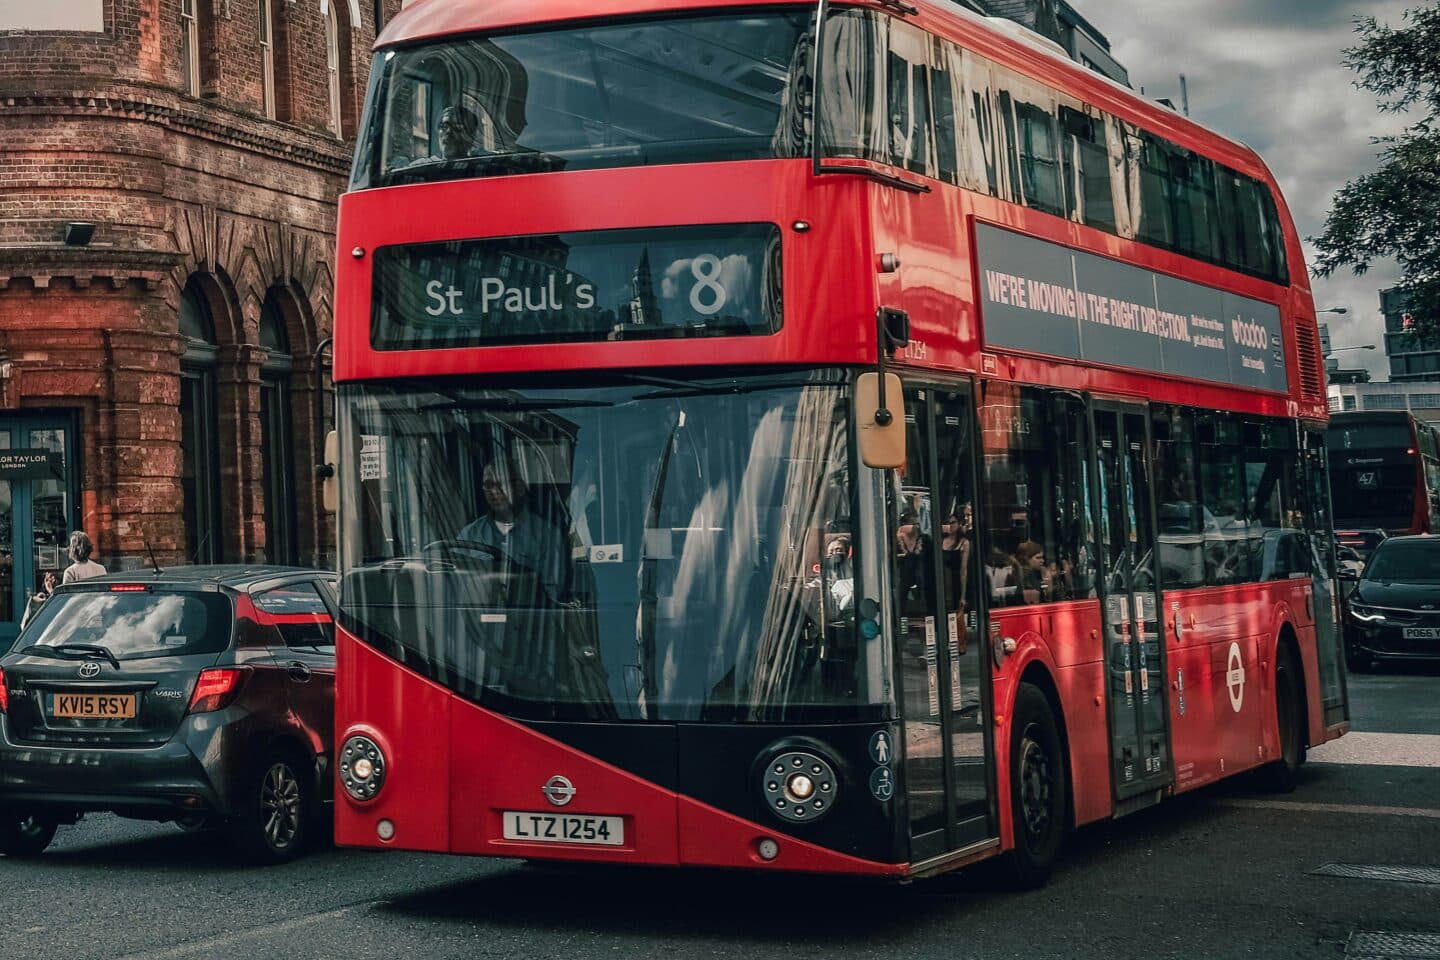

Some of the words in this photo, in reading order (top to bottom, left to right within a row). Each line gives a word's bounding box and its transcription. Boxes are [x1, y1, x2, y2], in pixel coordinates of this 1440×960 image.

[425, 280, 464, 316] St
[481, 274, 595, 314] Paul's
[689, 253, 727, 315] 8
[985, 269, 1027, 308] WE'RE
[1027, 279, 1075, 318] MOVING
[1076, 291, 1088, 320] IN
[1088, 293, 1110, 326] THE
[1110, 298, 1140, 331] RIGHT
[1140, 306, 1191, 342] DIRECTION.
[59, 697, 94, 714] KV15
[98, 697, 129, 715] RSY
[155, 690, 183, 698] YARIS
[516, 816, 556, 837] LTZ
[561, 818, 611, 840] 1254
